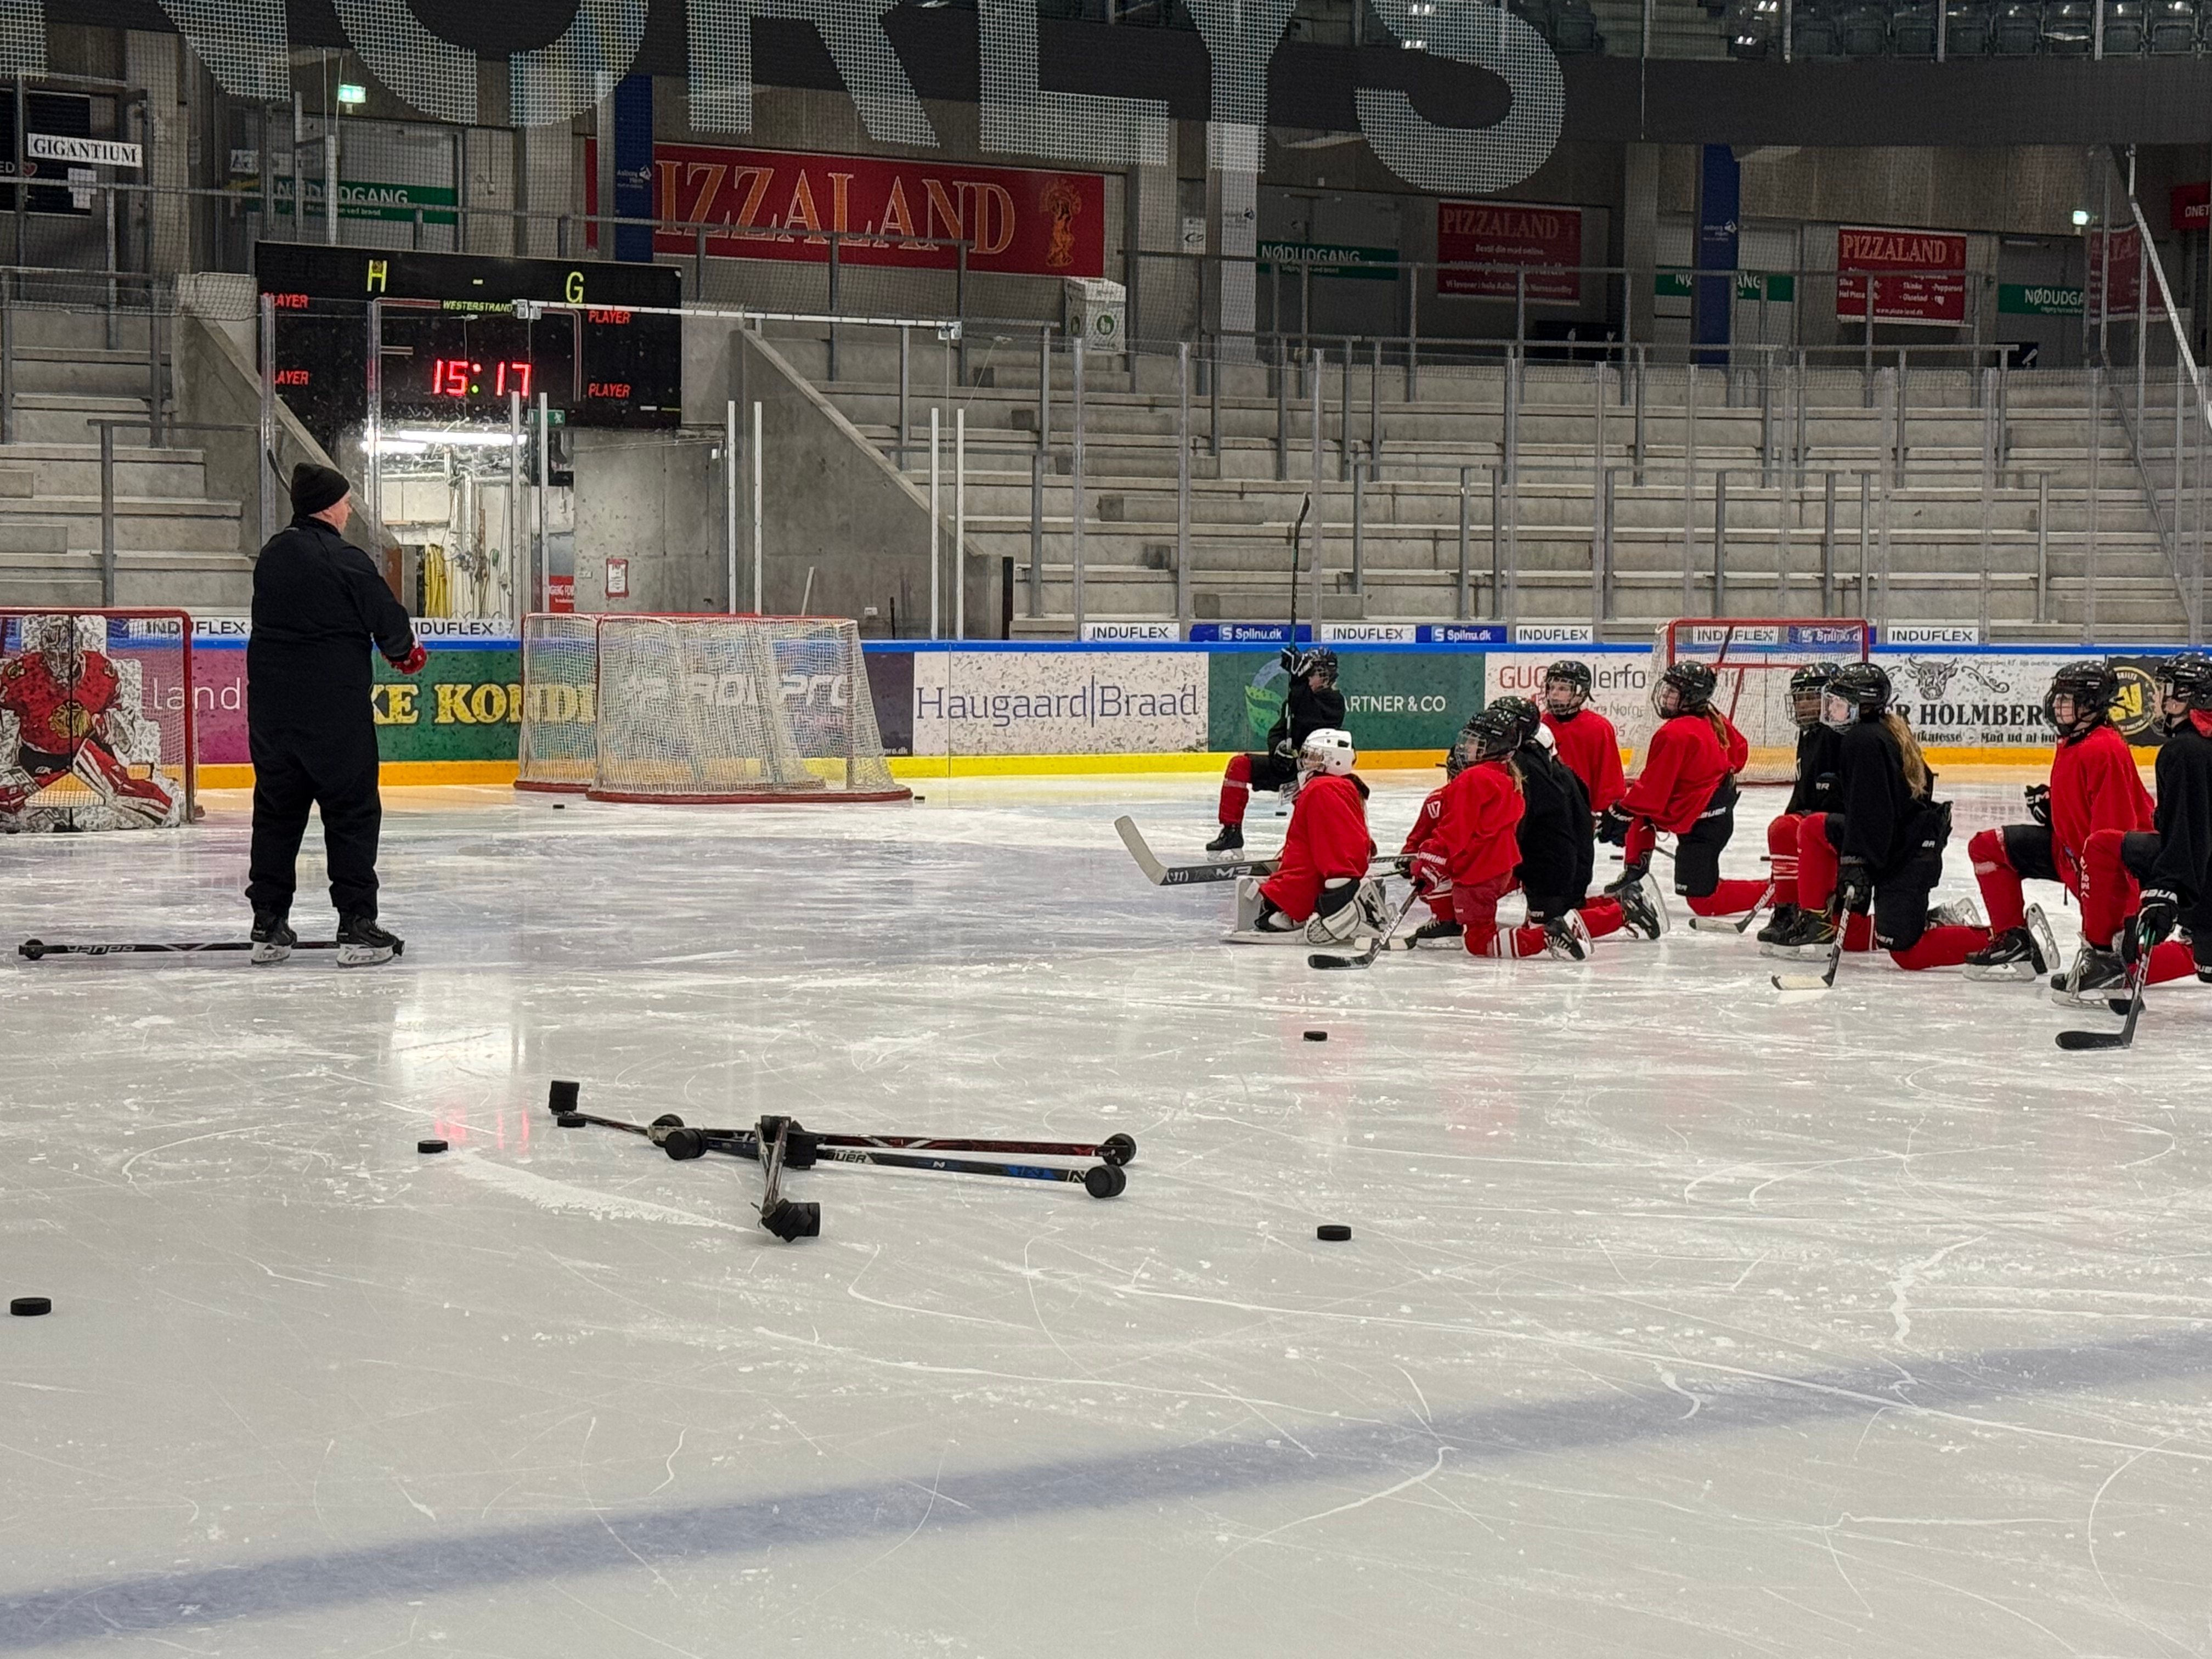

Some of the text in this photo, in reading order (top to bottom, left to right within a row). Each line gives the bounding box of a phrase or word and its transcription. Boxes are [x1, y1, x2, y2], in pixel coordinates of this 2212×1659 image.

[33, 138, 137, 163] GIGANTIUM
[655, 160, 1015, 254] IZZALAND
[1442, 208, 1559, 239] PIZZALAND
[1261, 244, 1361, 262] NØDUDGANG
[1842, 234, 1947, 263] PIZZALAND
[367, 259, 387, 292] H
[566, 271, 584, 303] G
[263, 292, 309, 308] AYER
[2024, 287, 2084, 306] NØDUDGA
[442, 300, 513, 313] WESTERSTRAND
[588, 311, 631, 325] PLAYER
[274, 370, 309, 385] AYER
[588, 383, 631, 398] PLAYER
[146, 621, 246, 635] INDFLEX
[415, 622, 493, 635] DUFLEX
[1092, 627, 1169, 639] INDUFLEX
[1333, 628, 1403, 640] INDUFLEX
[1519, 629, 1588, 641] INDUFLEX
[1697, 629, 1774, 642] INDFLEX
[1892, 630, 1973, 642] INDUFLEX
[1344, 696, 1446, 712] RTNER & CO
[1920, 704, 2044, 726] HOLMBER
[825, 1150, 867, 1164] AUER
